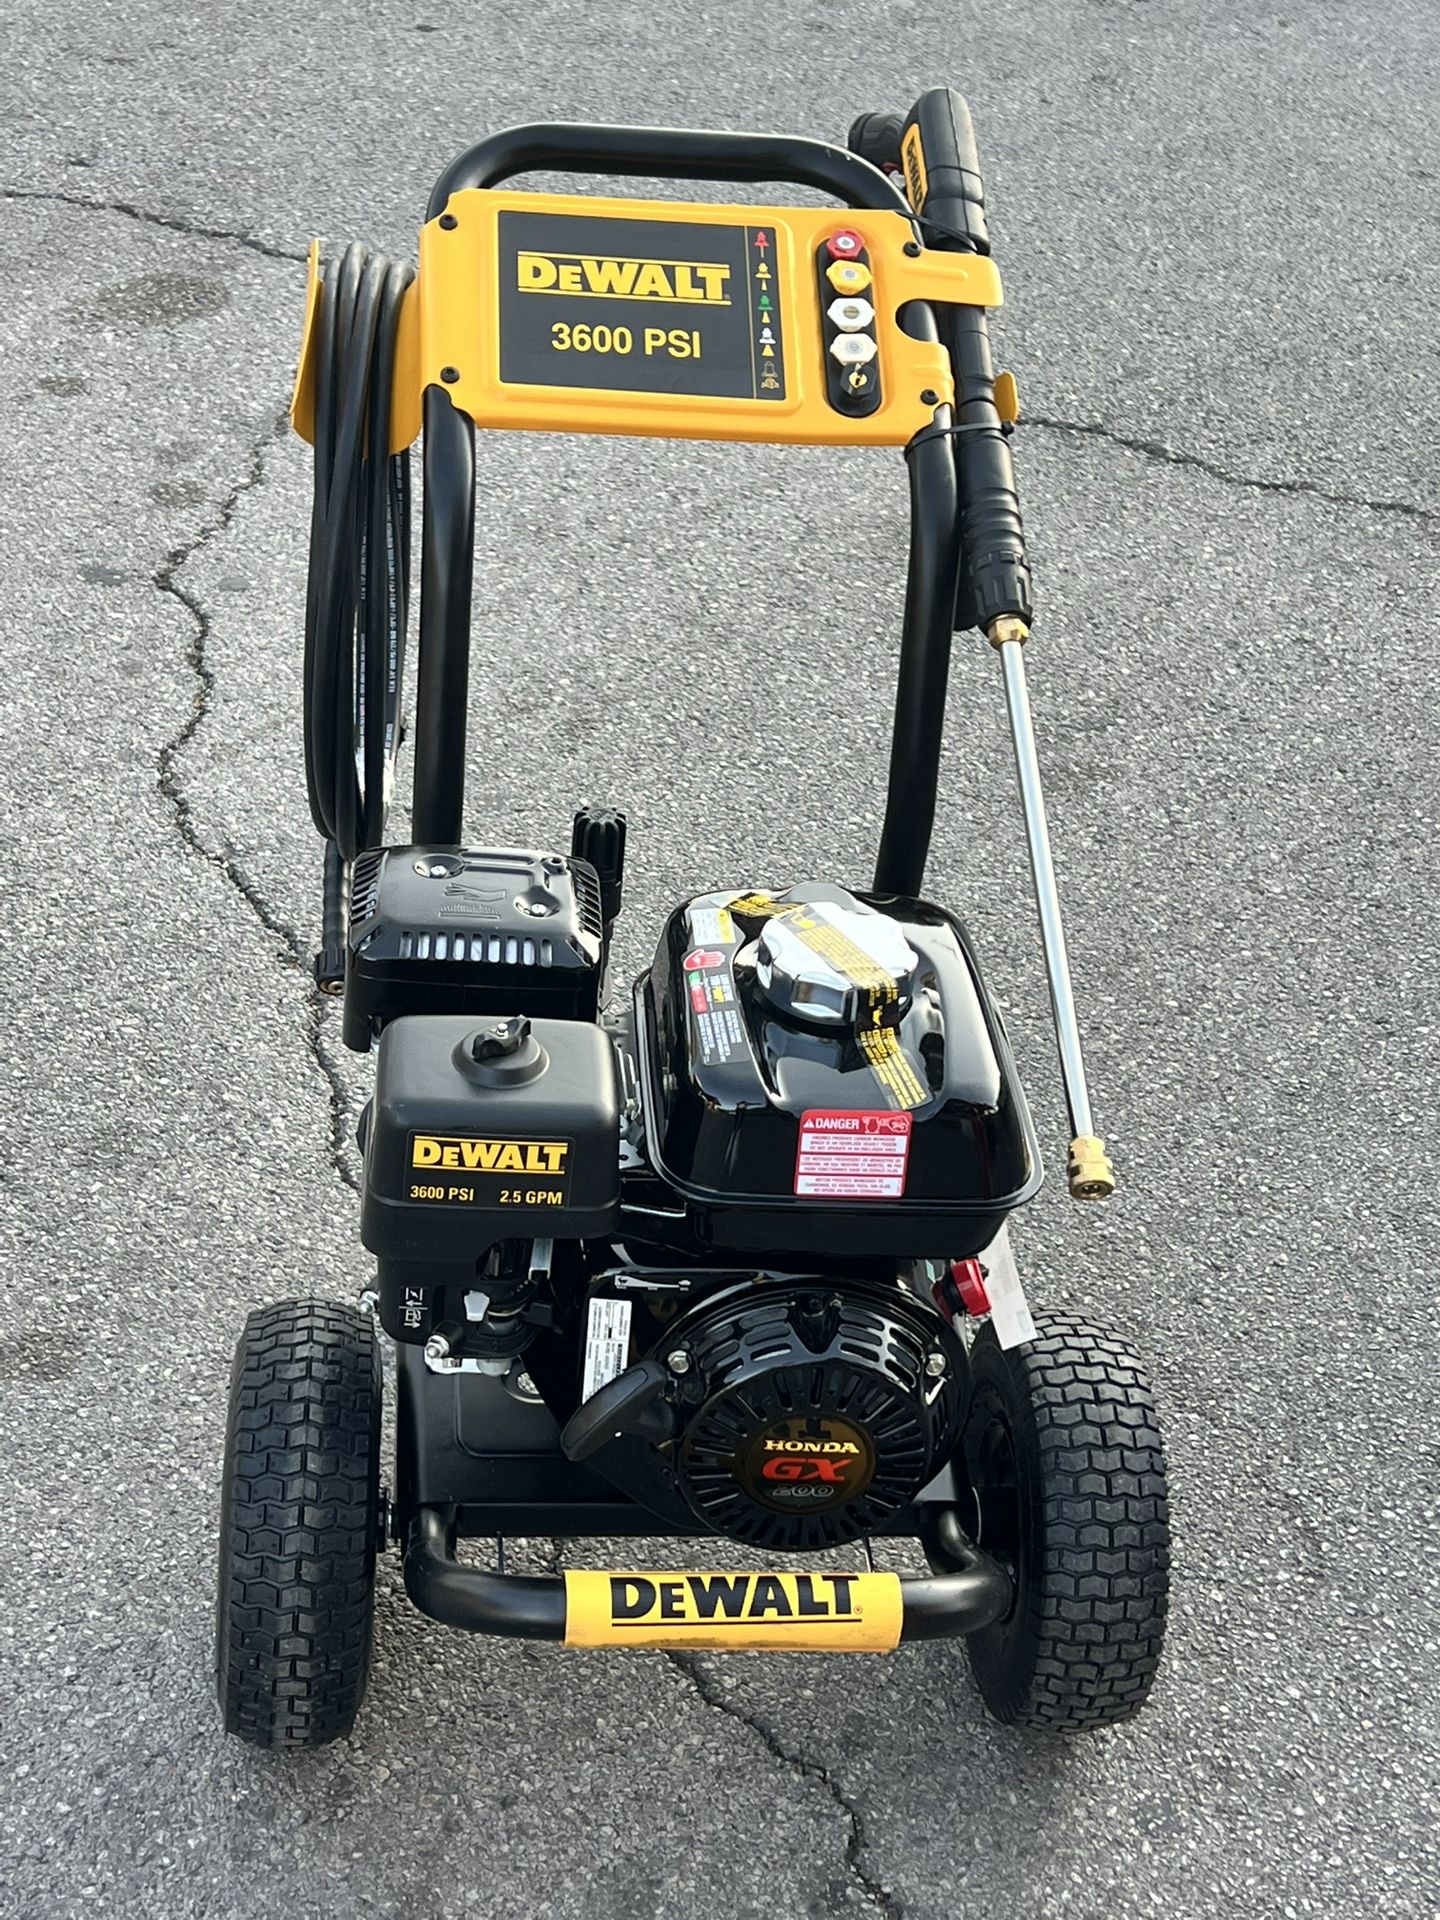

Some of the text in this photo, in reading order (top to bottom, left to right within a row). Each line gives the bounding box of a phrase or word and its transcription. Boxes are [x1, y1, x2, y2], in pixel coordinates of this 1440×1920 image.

[551, 321, 701, 359] 3600 PSI
[815, 1117, 860, 1131] DANGER
[412, 1138, 568, 1171] DEWALT
[409, 1185, 563, 1206] 3600 PSI 2.5 GPM
[763, 1439, 860, 1454] HONDA
[761, 1456, 855, 1484] GX
